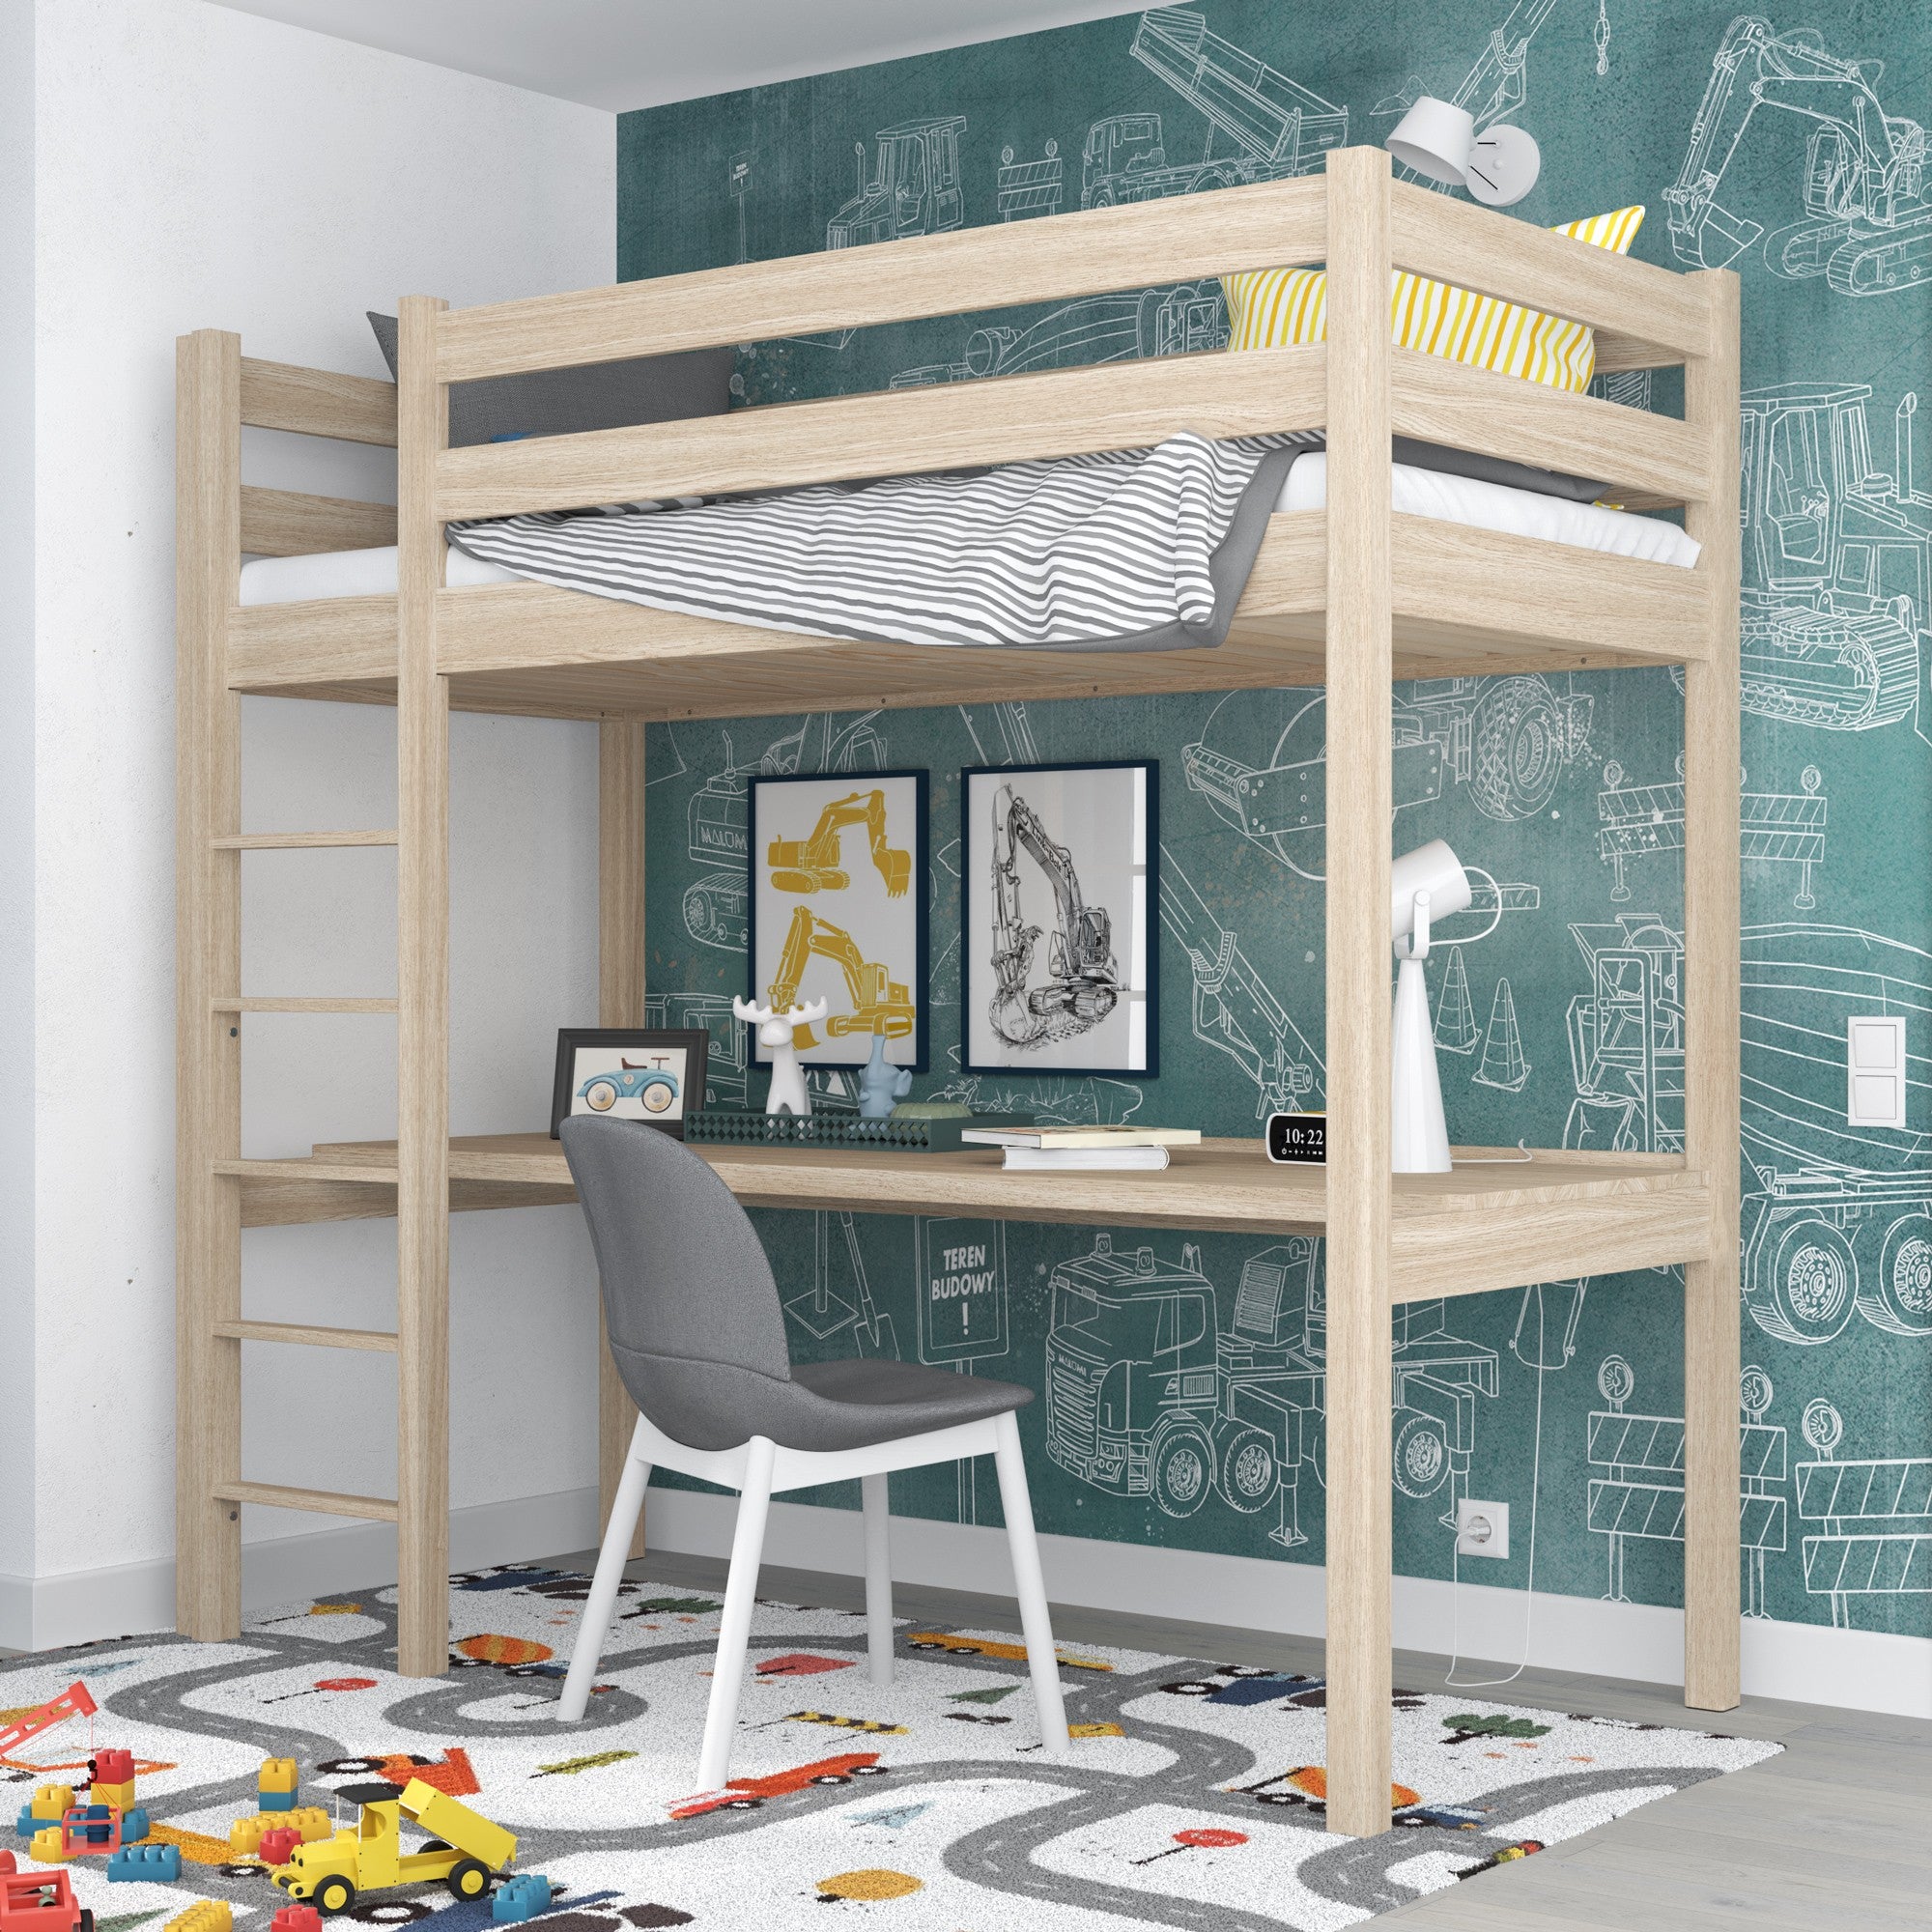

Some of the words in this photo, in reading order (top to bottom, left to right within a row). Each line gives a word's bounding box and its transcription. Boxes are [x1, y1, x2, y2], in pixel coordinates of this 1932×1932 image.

[1285, 1127, 1324, 1146] 10:22
[943, 1244, 986, 1271] TEREN
[931, 1270, 995, 1301] BUDOWY
[962, 1301, 969, 1336] !
